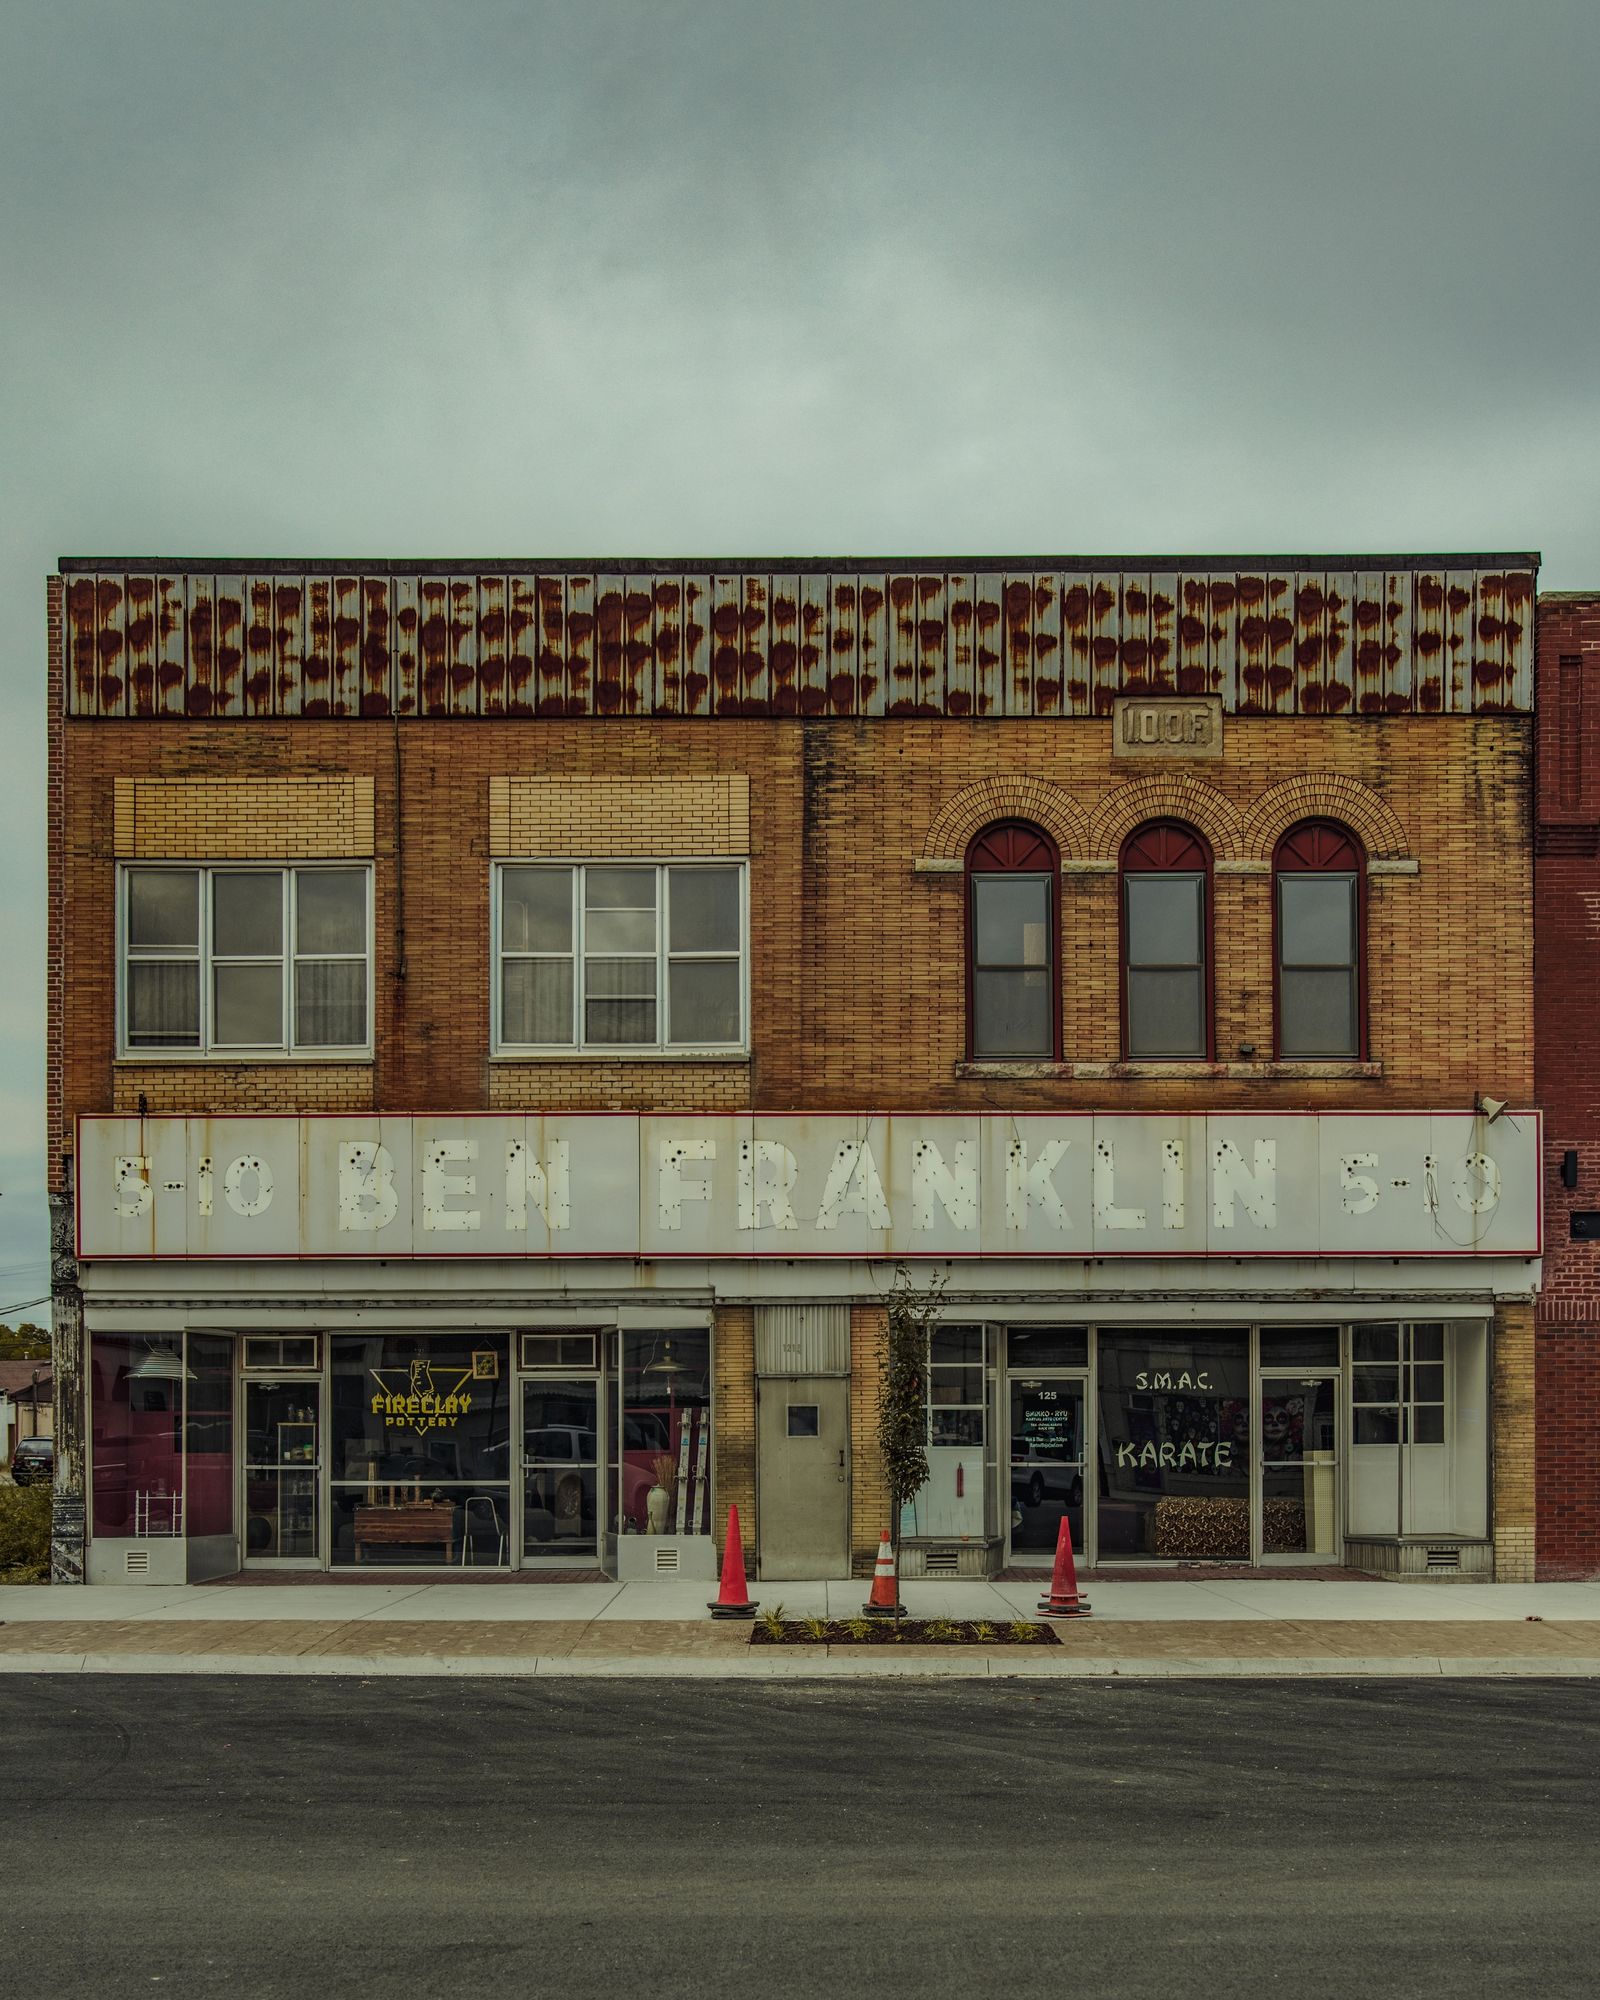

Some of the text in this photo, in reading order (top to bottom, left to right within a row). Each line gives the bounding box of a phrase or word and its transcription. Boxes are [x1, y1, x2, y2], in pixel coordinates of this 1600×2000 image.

[338, 1140, 571, 1231] BEN
[658, 1139, 1277, 1231] FRANKLIN
[1136, 1371, 1213, 1390] S.M.A.C.
[371, 1392, 472, 1414] FIRECLAY
[1038, 1391, 1057, 1400] 125
[386, 1417, 458, 1427] POTTERY
[1115, 1440, 1232, 1468] KARATE
